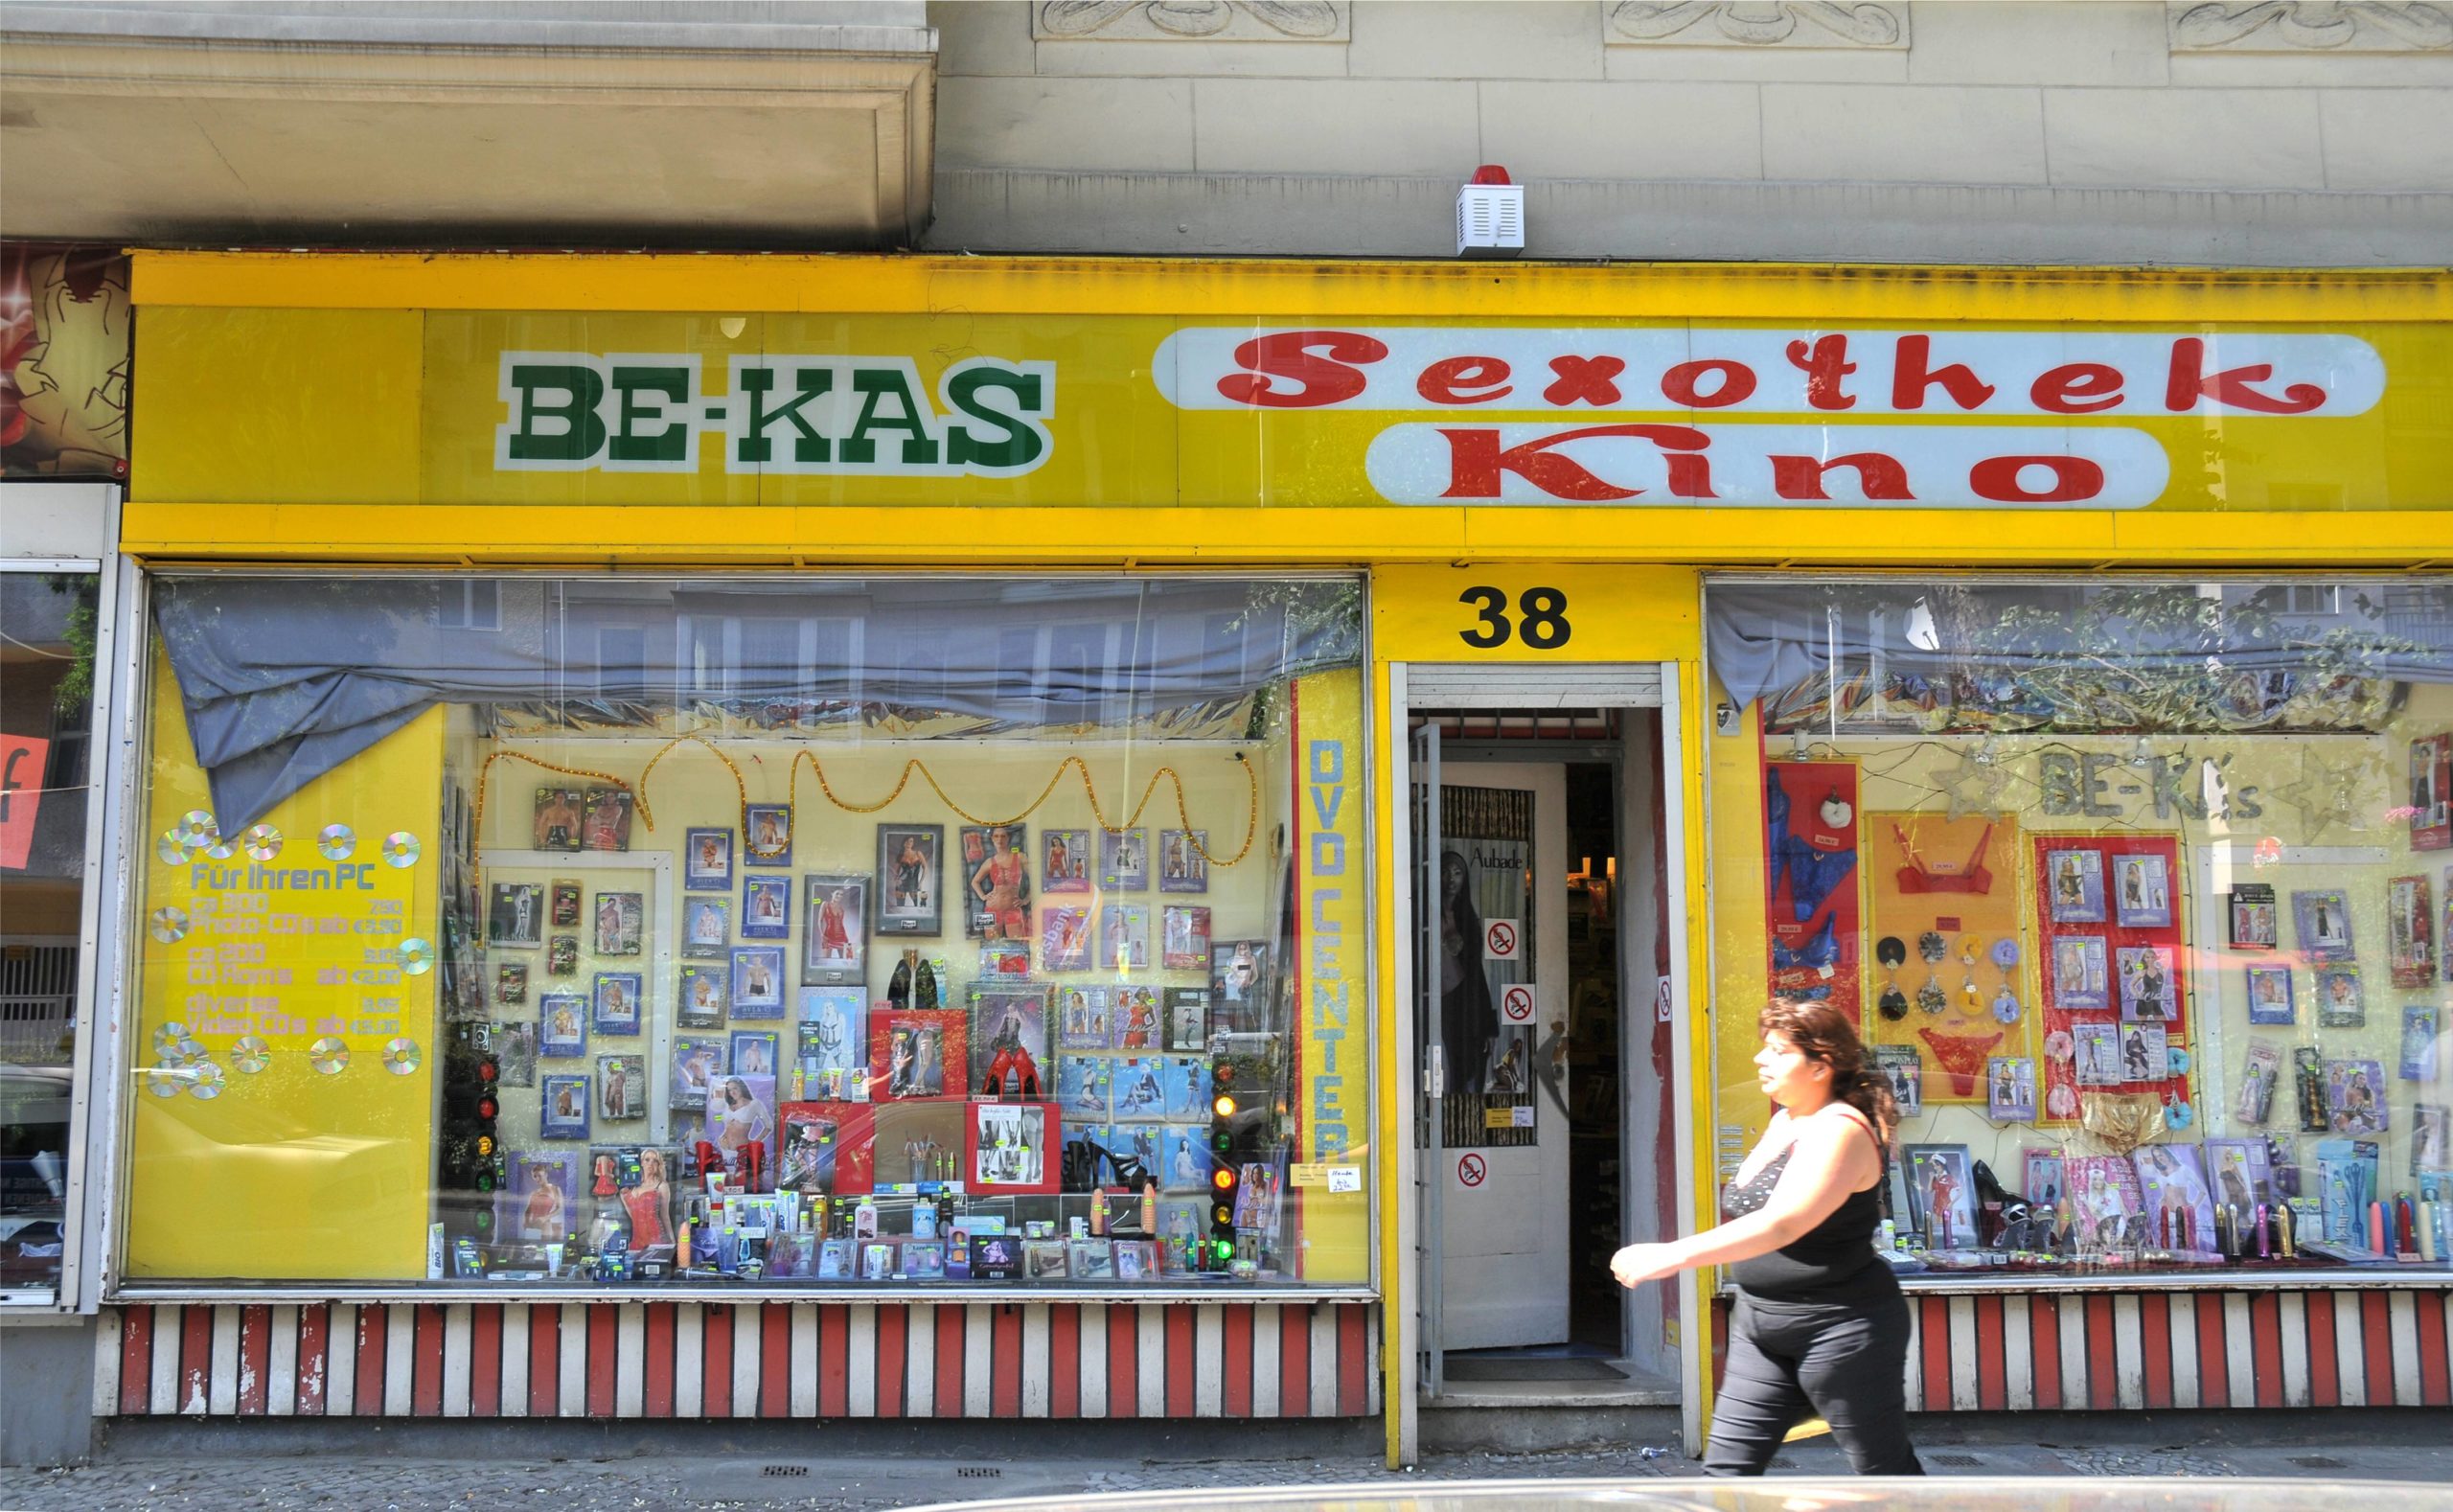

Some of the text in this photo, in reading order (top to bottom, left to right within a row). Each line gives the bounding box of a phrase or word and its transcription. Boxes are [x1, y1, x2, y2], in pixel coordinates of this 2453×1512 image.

[1216, 331, 2327, 416] Sexothek
[509, 365, 1043, 468] BE-KAS
[1434, 424, 2105, 503] Kino
[1458, 585, 1572, 650] 38
[1309, 740, 1345, 876] DVD
[1471, 847, 1523, 869] Aubade
[190, 862, 376, 889] Für Ihren PC
[190, 897, 218, 914] ca
[222, 893, 269, 913] 300
[318, 913, 348, 934] ab
[188, 947, 215, 963] ca
[218, 944, 265, 963] 200
[316, 964, 347, 985] ab
[187, 992, 280, 1013] diverse
[315, 1015, 345, 1035] ab
[1312, 888, 1349, 1163] CENTER
